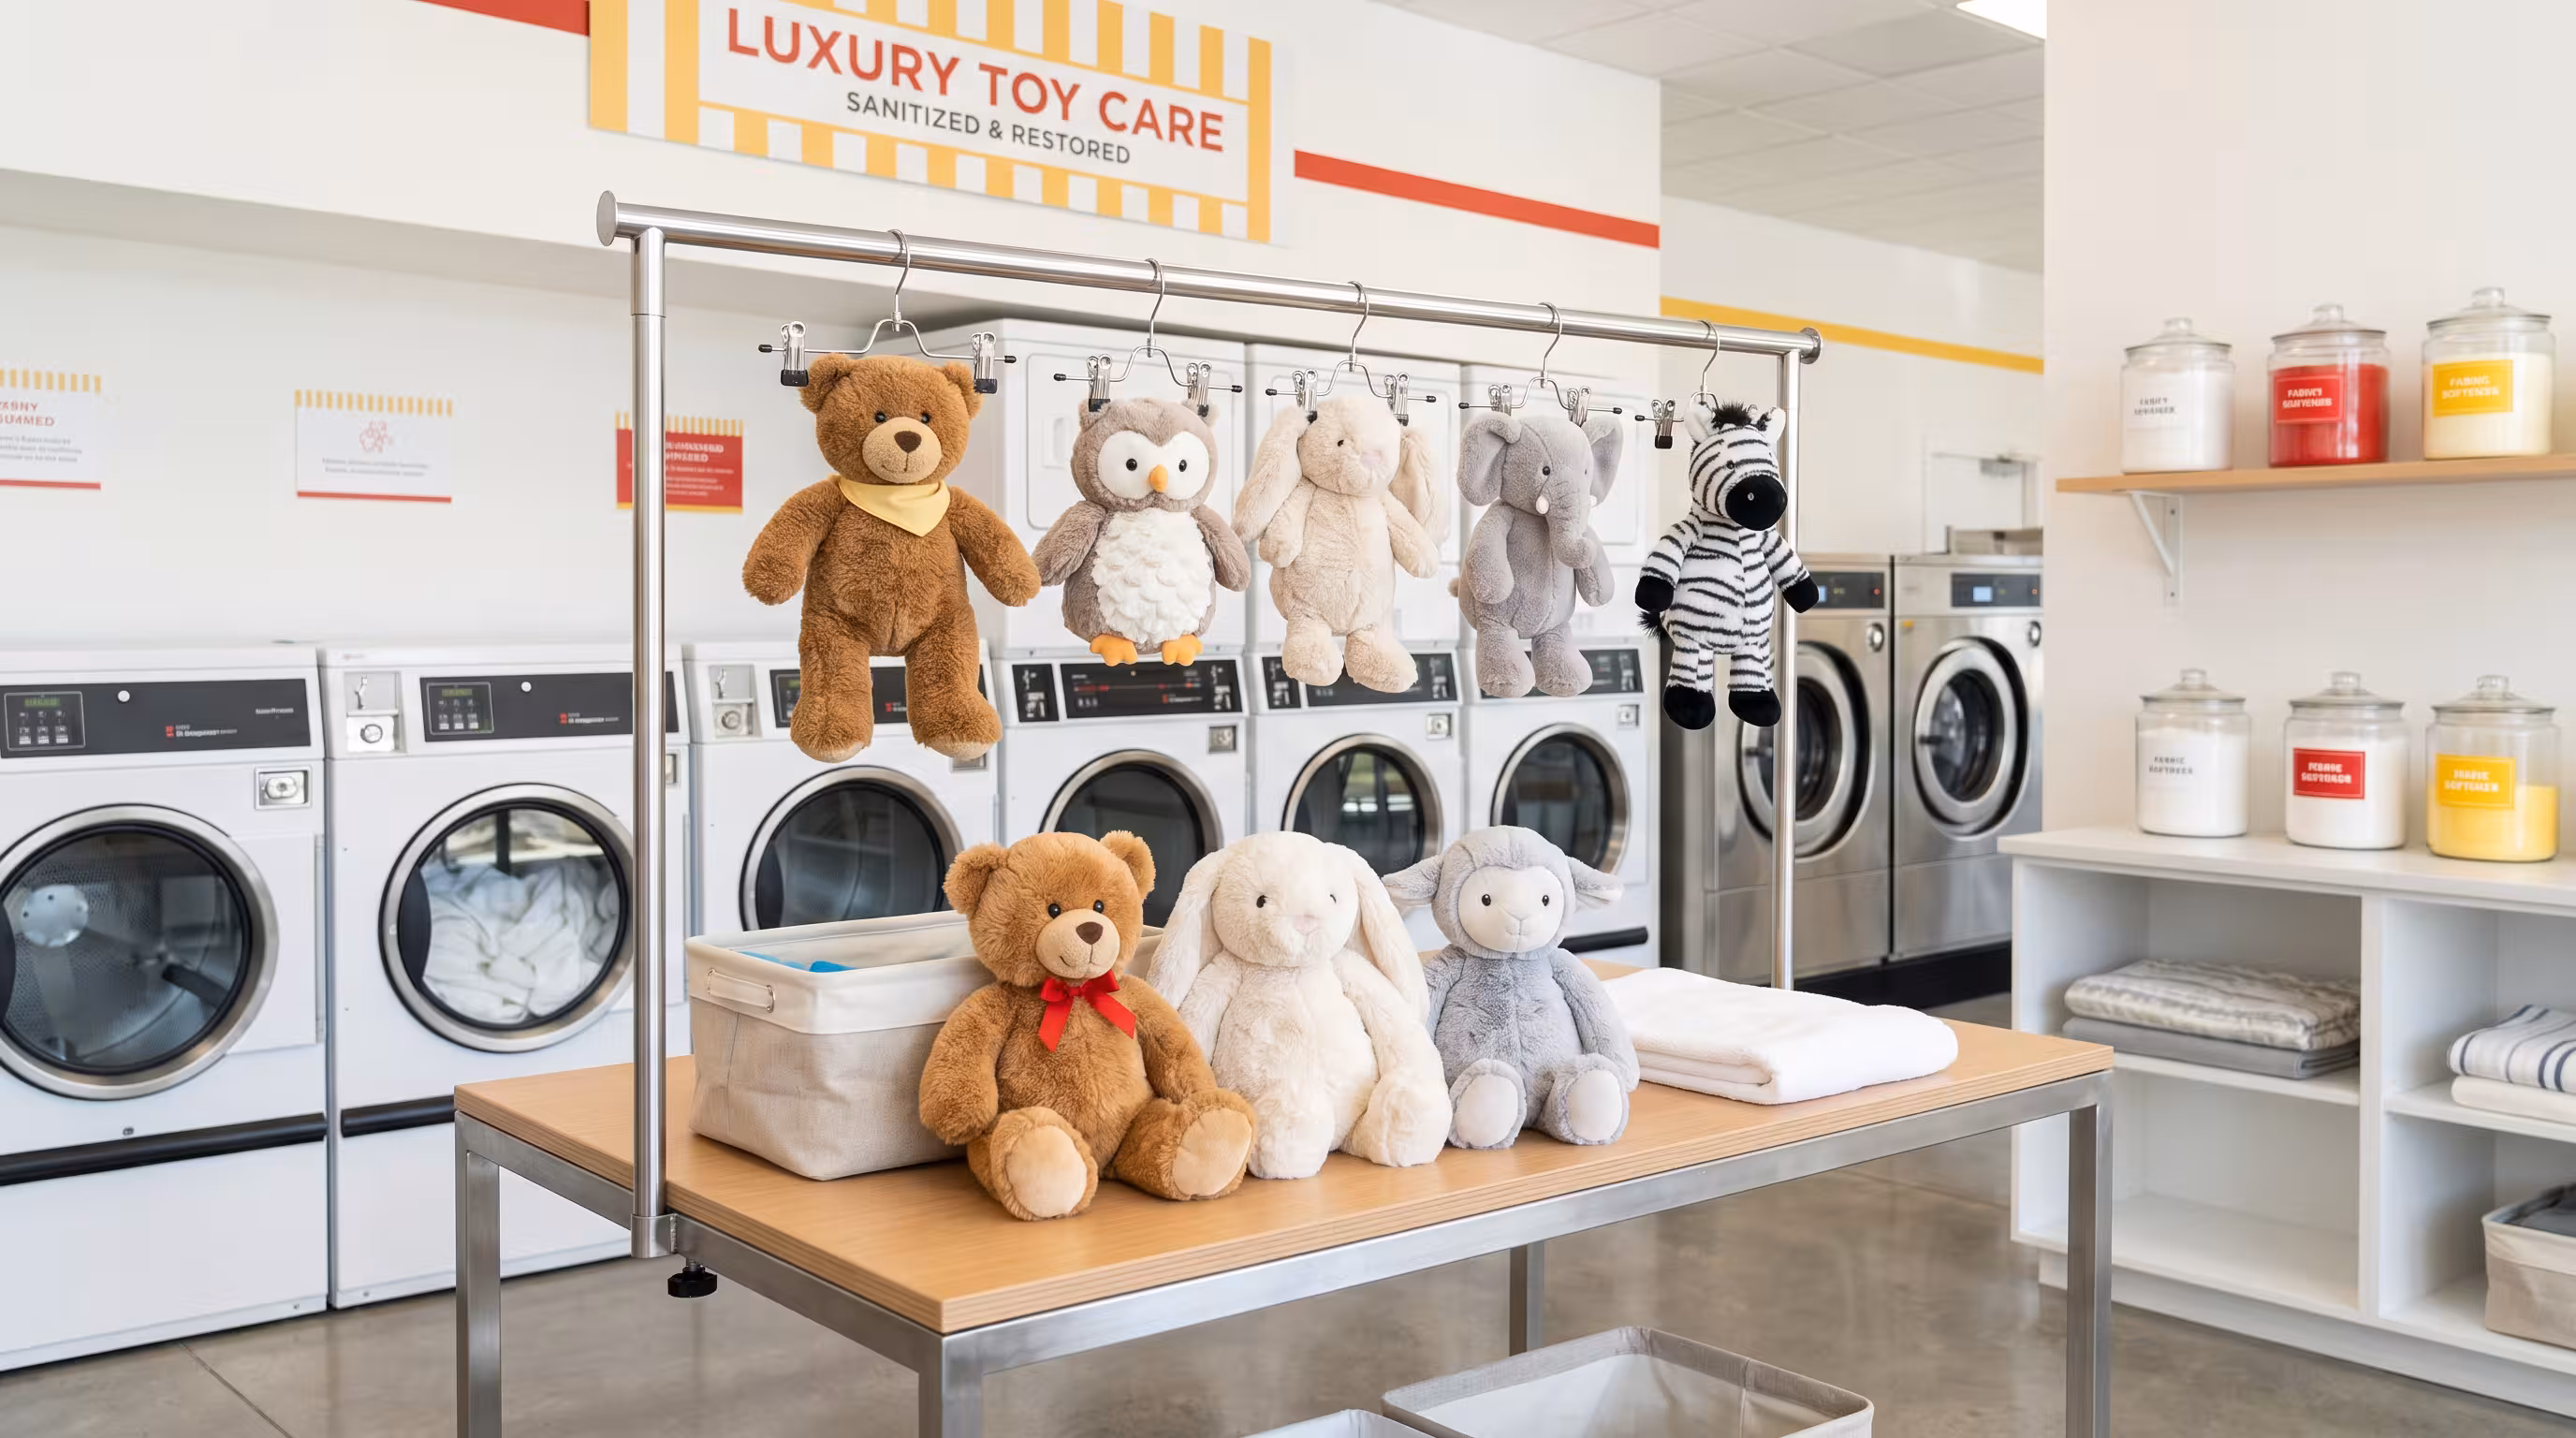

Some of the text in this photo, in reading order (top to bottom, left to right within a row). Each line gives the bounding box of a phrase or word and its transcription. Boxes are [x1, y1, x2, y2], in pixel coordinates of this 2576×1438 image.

[728, 8, 1224, 153] LUXURY TOY CARE
[846, 92, 1131, 165] SANITIZED & RESTORED
